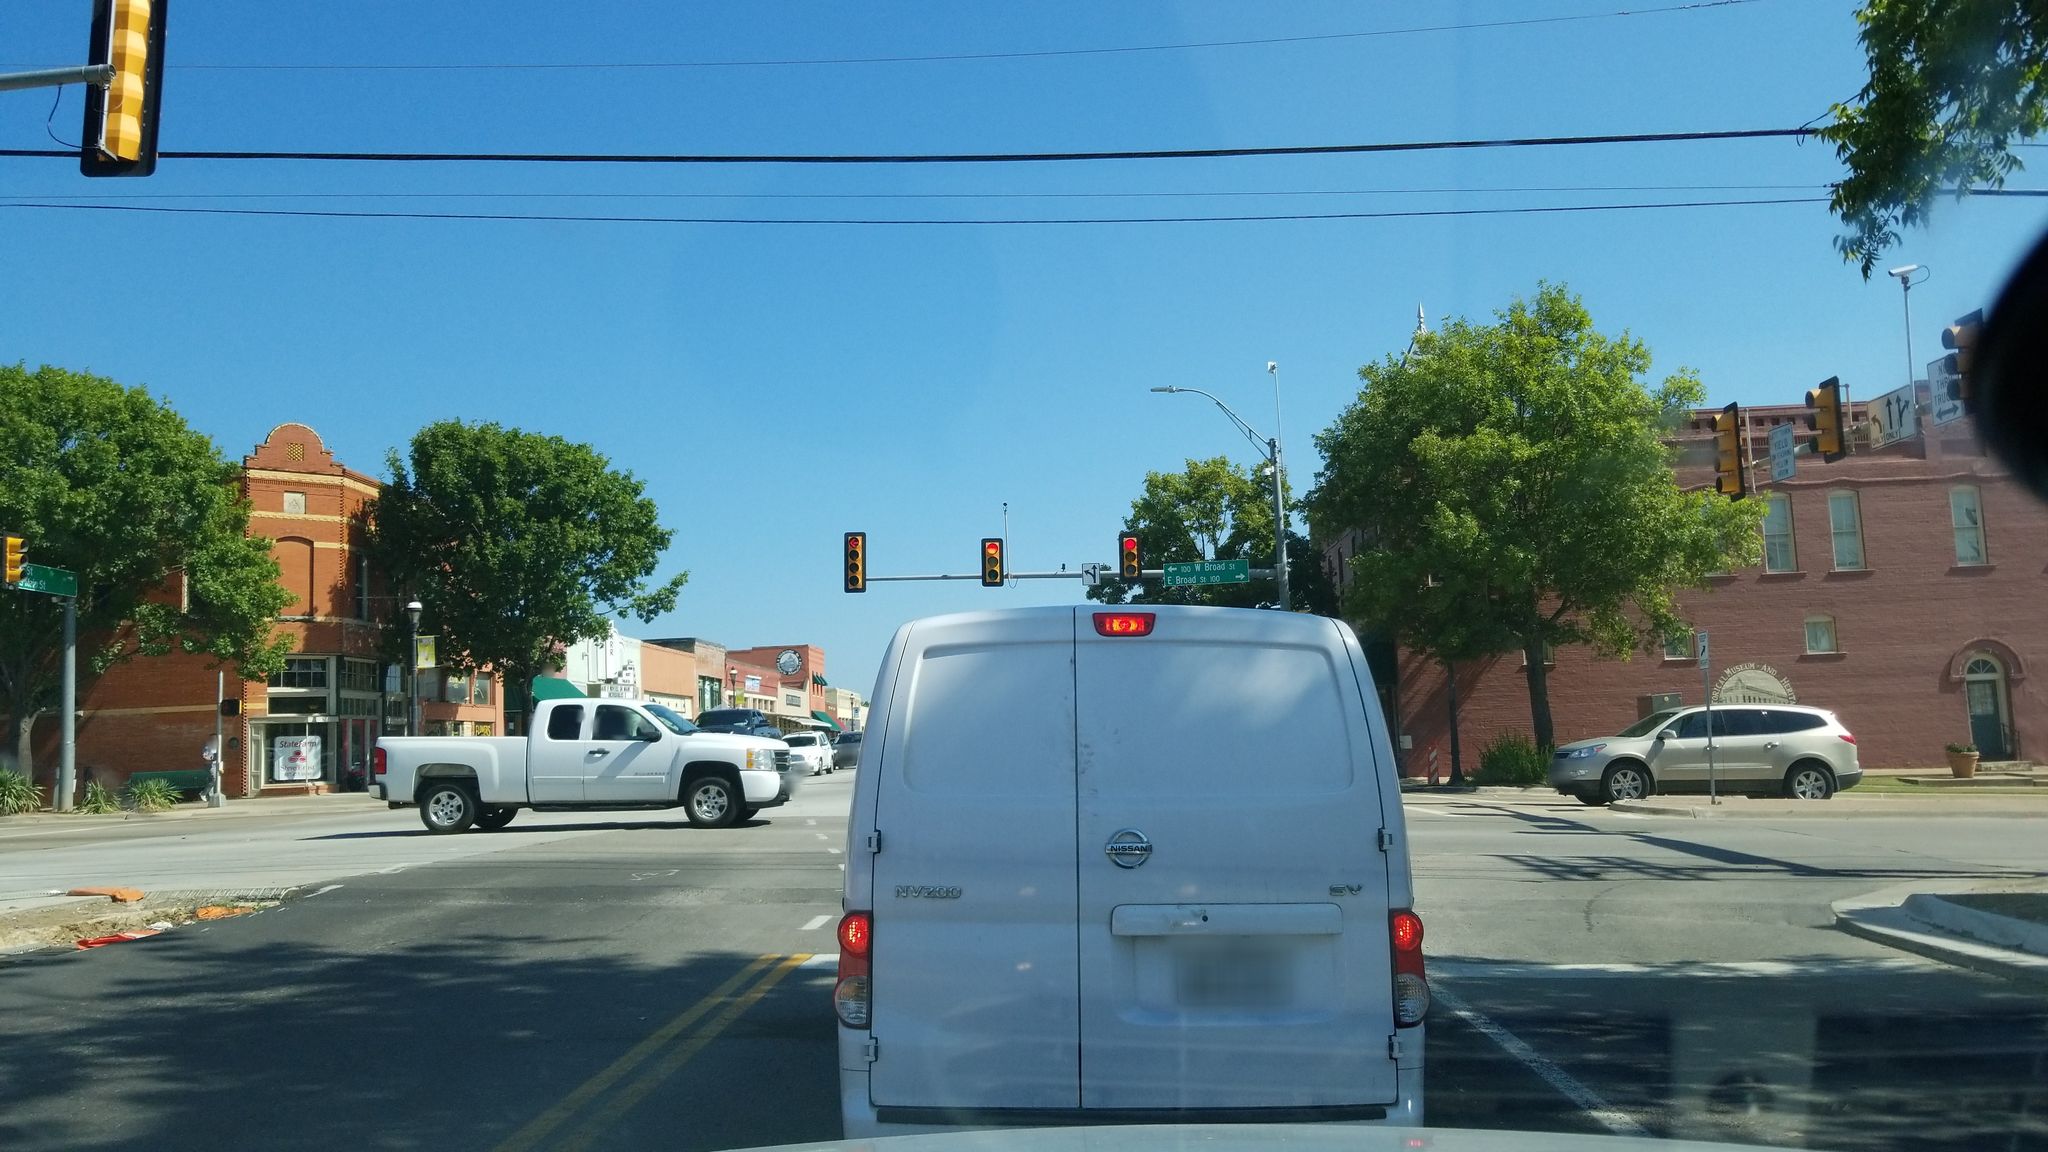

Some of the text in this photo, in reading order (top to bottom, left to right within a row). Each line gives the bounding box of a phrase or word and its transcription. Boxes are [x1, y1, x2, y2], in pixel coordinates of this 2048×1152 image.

[1886, 431, 1898, 441] ONLY
[27, 566, 33, 576] St
[1181, 565, 1191, 573] 100
[1195, 563, 1201, 572] W
[1204, 562, 1226, 572] Broad
[39, 580, 46, 590] St
[1167, 576, 1172, 584] E
[1175, 575, 1197, 585] Broad
[1209, 575, 1220, 583] 100
[1110, 844, 1148, 852] NISSAN
[894, 885, 962, 899] NV200
[1329, 883, 1363, 896] SV
